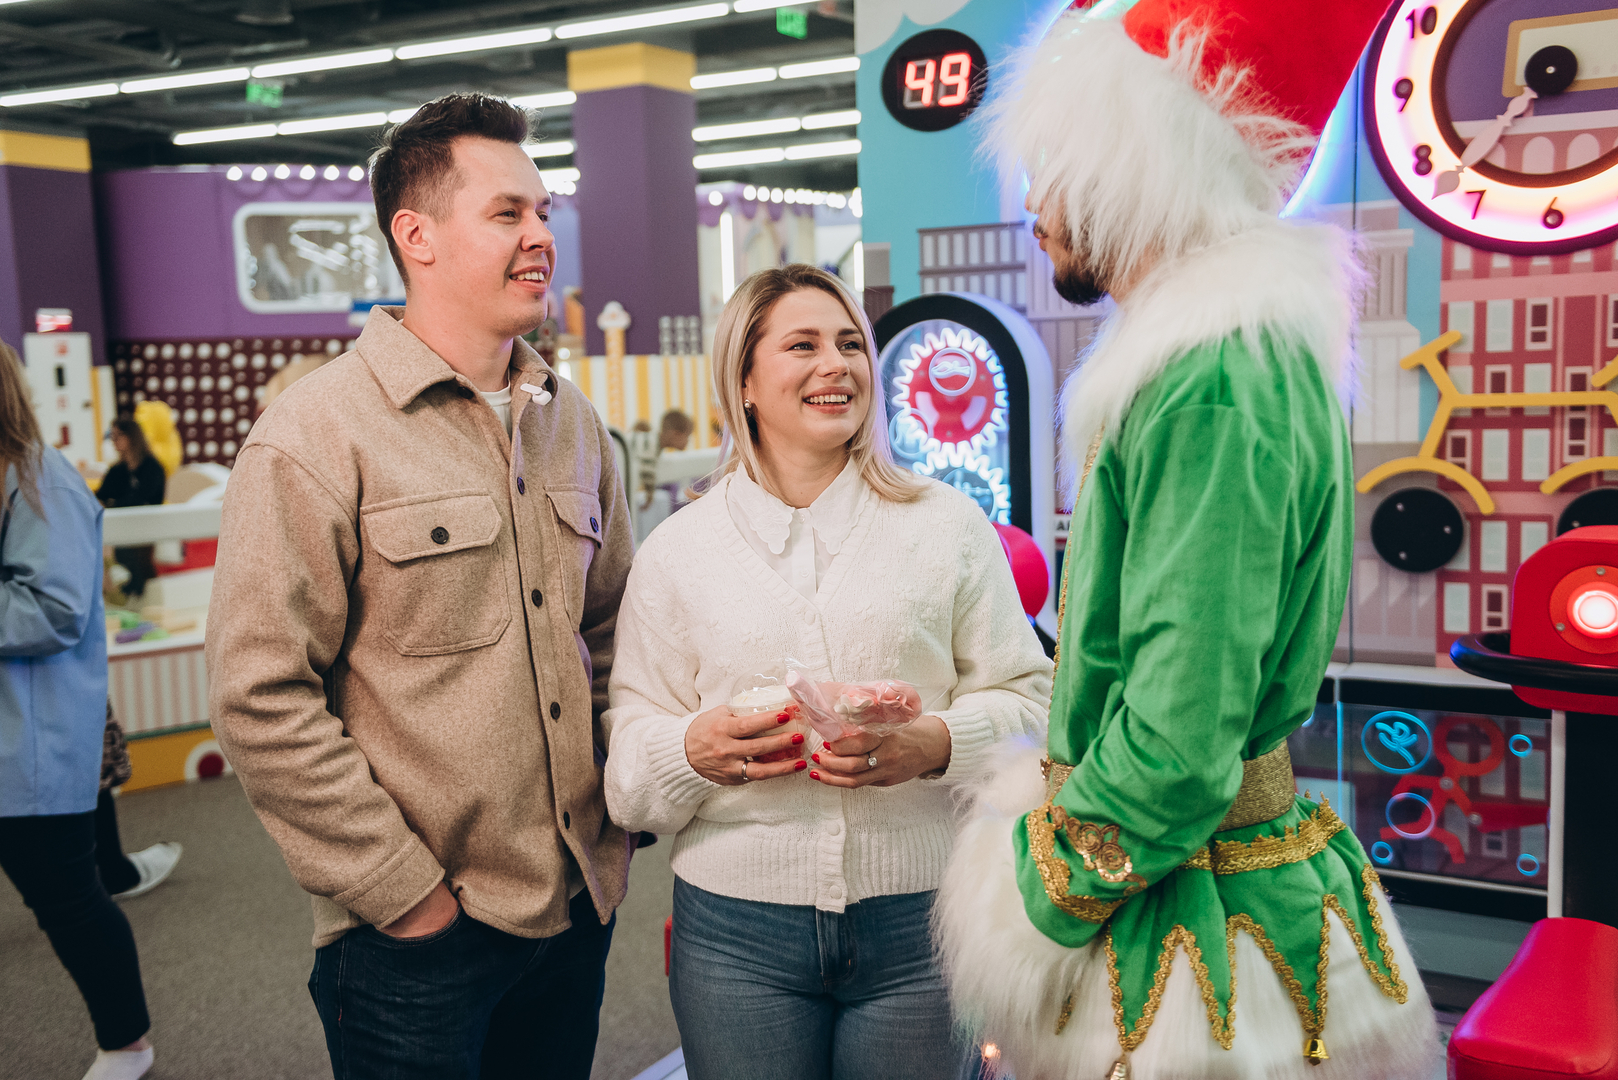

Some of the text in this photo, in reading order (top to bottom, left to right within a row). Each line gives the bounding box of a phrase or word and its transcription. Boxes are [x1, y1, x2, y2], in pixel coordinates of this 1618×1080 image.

[1405, 6, 1437, 39] 10
[904, 53, 971, 107] 49
[1394, 78, 1414, 112] 9
[1414, 144, 1432, 176] 8
[1465, 190, 1486, 220] 7
[1543, 197, 1564, 229] 6
